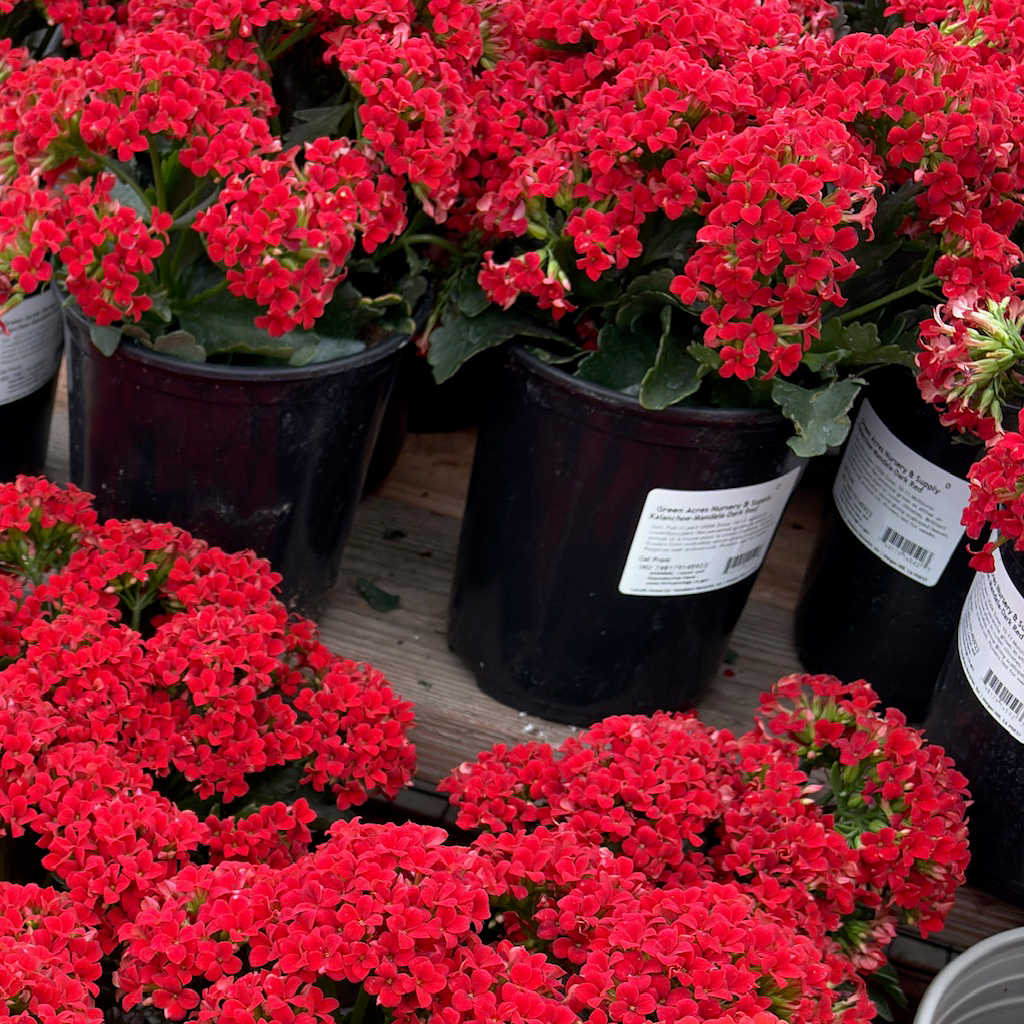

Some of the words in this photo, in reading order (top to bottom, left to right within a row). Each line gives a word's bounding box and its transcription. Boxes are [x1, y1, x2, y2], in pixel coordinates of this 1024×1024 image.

[915, 475, 941, 495] Supply
[657, 505, 683, 513] Green
[710, 502, 741, 513] Nursery
[997, 585, 1013, 616] Nursery
[1012, 613, 1018, 622] &
